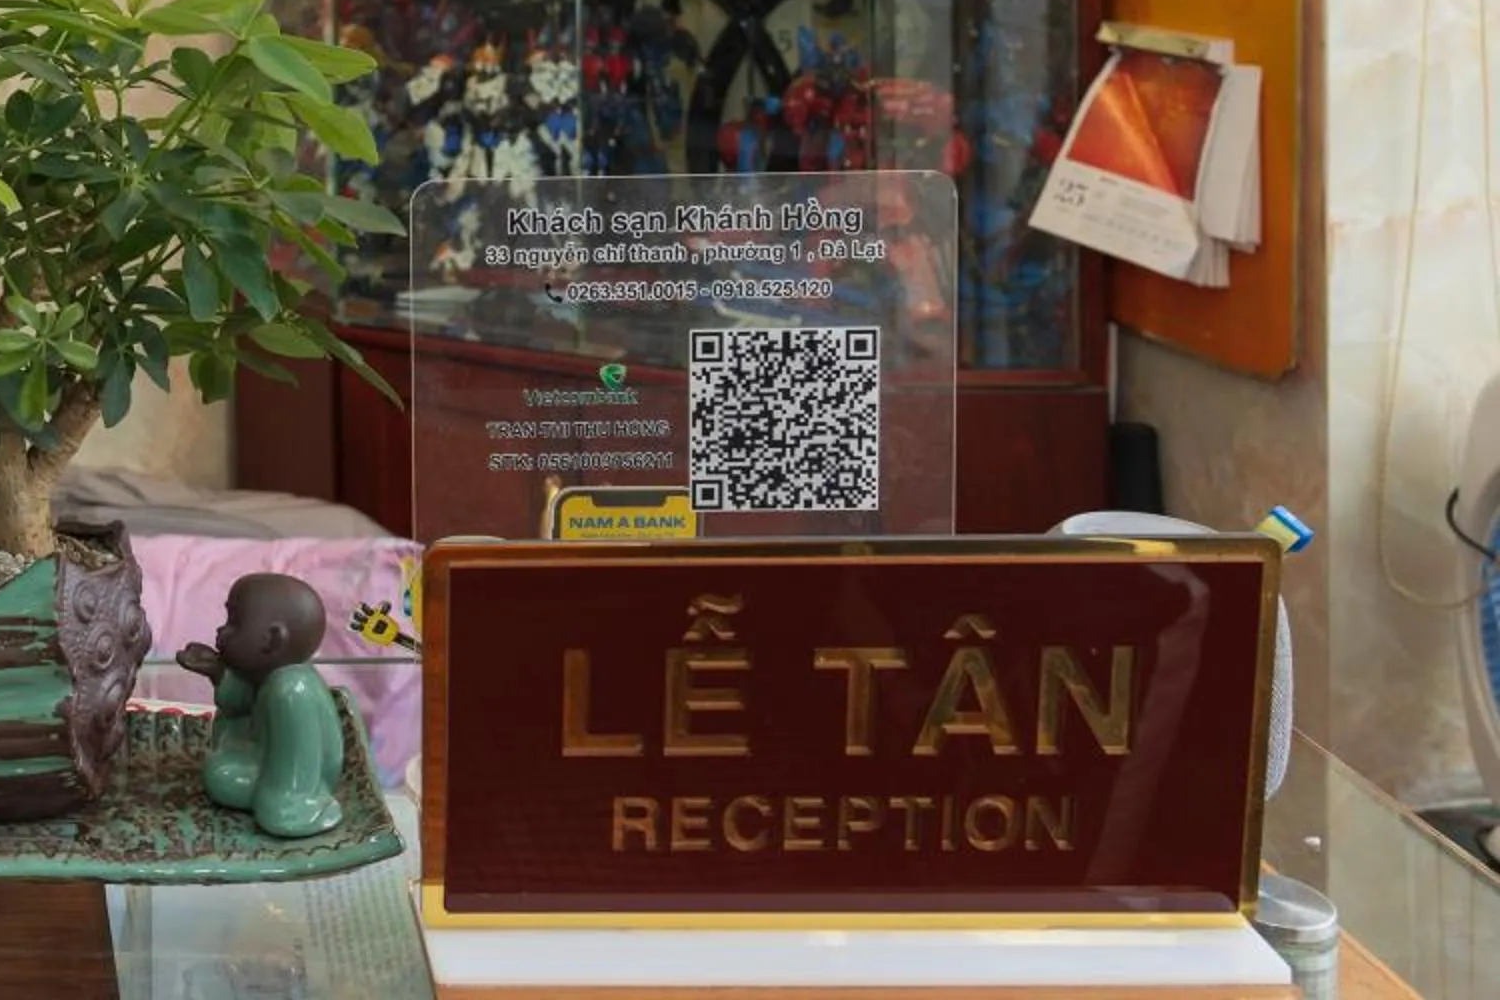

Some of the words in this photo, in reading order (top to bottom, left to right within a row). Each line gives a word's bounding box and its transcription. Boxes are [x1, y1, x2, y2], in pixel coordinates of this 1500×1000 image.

[508, 207, 603, 235] Khách
[612, 212, 666, 238] sạn
[676, 204, 772, 233] Khánh
[782, 197, 863, 234] Hồng
[485, 245, 509, 264] 33
[629, 243, 686, 262] thanh
[851, 239, 886, 262] Lạt
[567, 281, 697, 301] 0263.351.0015
[712, 279, 833, 299] 0918.525.120
[569, 516, 613, 529] NAM
[617, 516, 630, 529] A
[634, 515, 686, 529] BANK
[562, 593, 752, 757] LỄ
[813, 613, 1131, 756] TÂN
[612, 796, 1077, 852] RECEPTION
